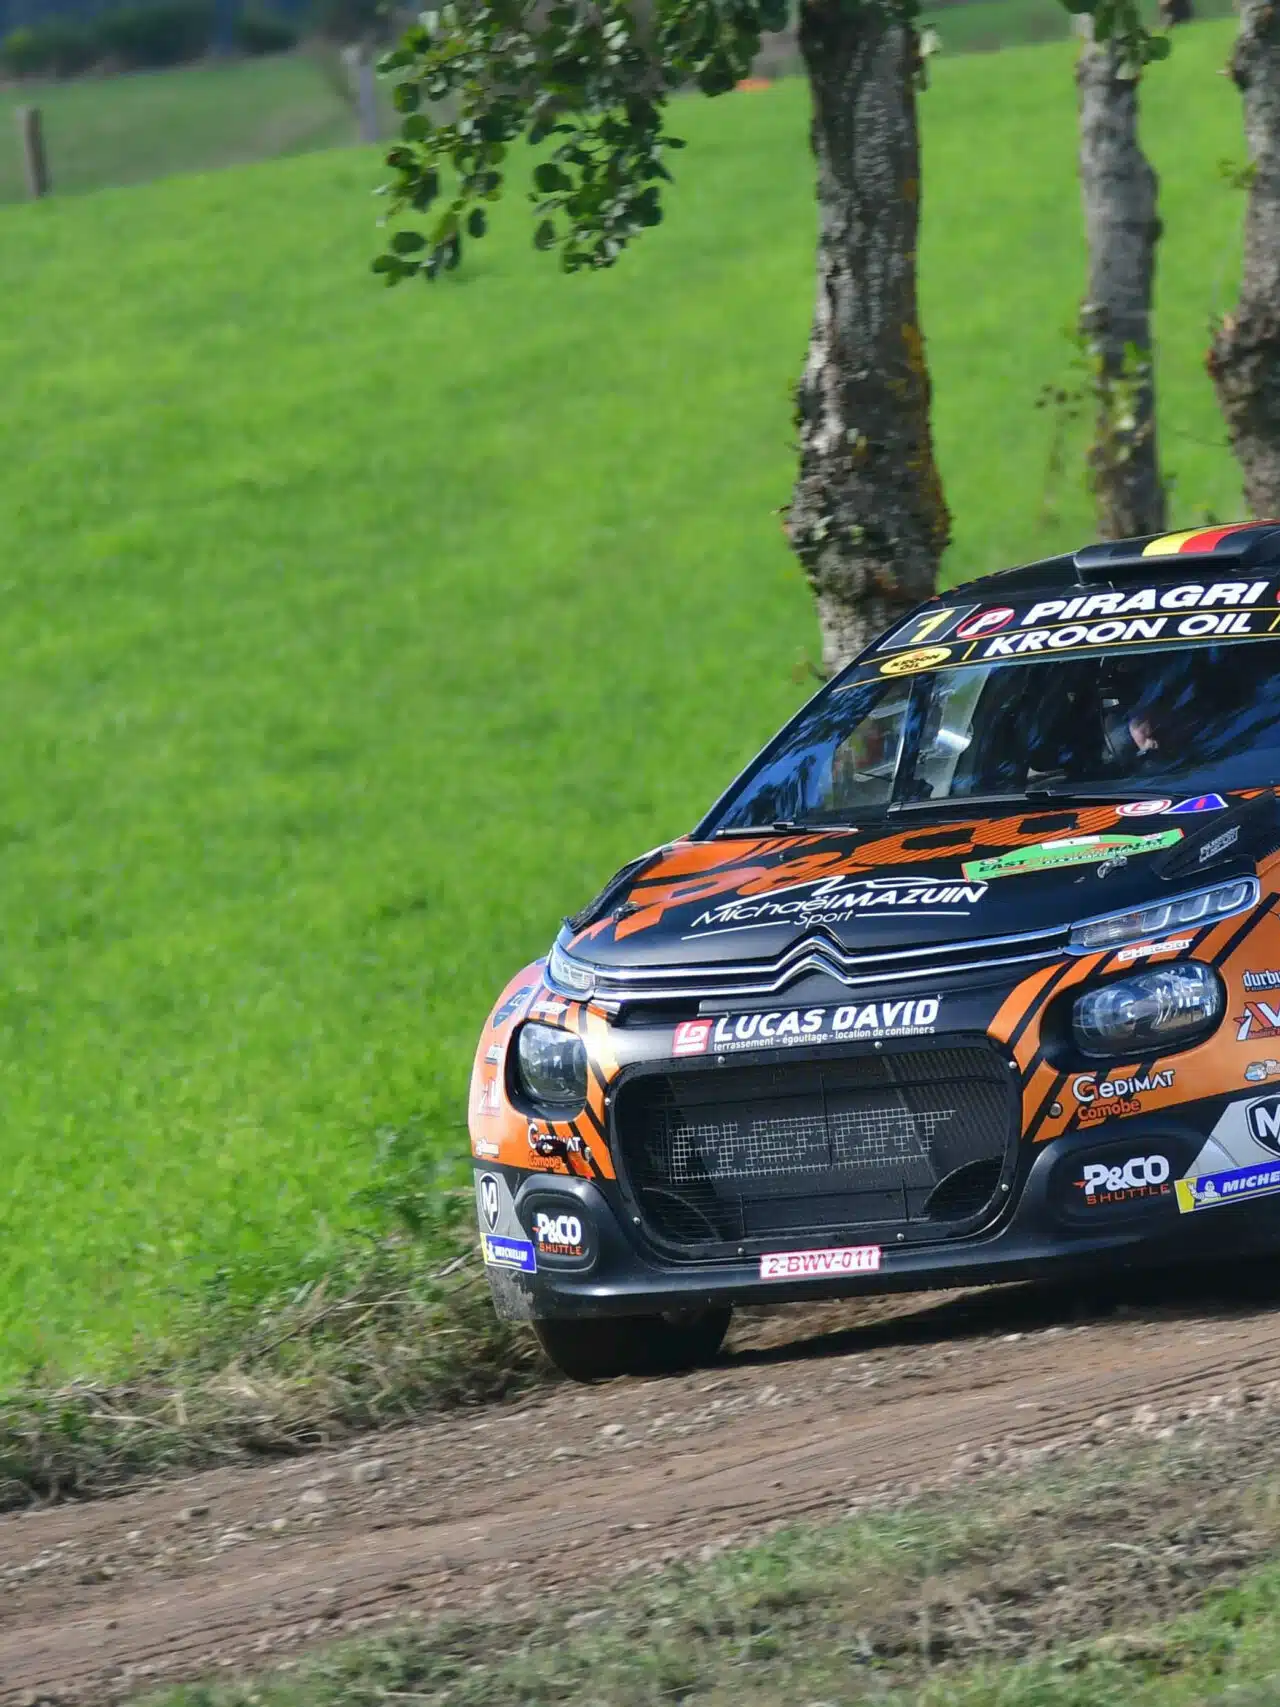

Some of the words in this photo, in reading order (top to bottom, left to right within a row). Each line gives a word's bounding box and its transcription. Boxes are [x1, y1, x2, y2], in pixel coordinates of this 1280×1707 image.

[1020, 581, 1270, 627] PIRAGRI
[909, 609, 955, 643] 1
[982, 617, 1168, 658] KROON
[1177, 612, 1252, 636] OIL
[977, 858, 1030, 873] EAST
[831, 886, 989, 909] MAZUIN
[793, 909, 854, 929] Sport
[713, 1008, 826, 1042] LUCAS
[831, 998, 940, 1031] DAVID
[713, 1038, 774, 1052] terrassement
[835, 1028, 871, 1039] location
[873, 1026, 884, 1036] de
[885, 1025, 935, 1036] containers
[1077, 1098, 1142, 1122] Comobe
[1083, 1154, 1170, 1196] P&CO
[1086, 1184, 1171, 1205] SHUTTLE
[536, 1212, 582, 1246] P&CO
[539, 1242, 583, 1257] SHUTTLE
[767, 1250, 875, 1275] 2-BWV-011
